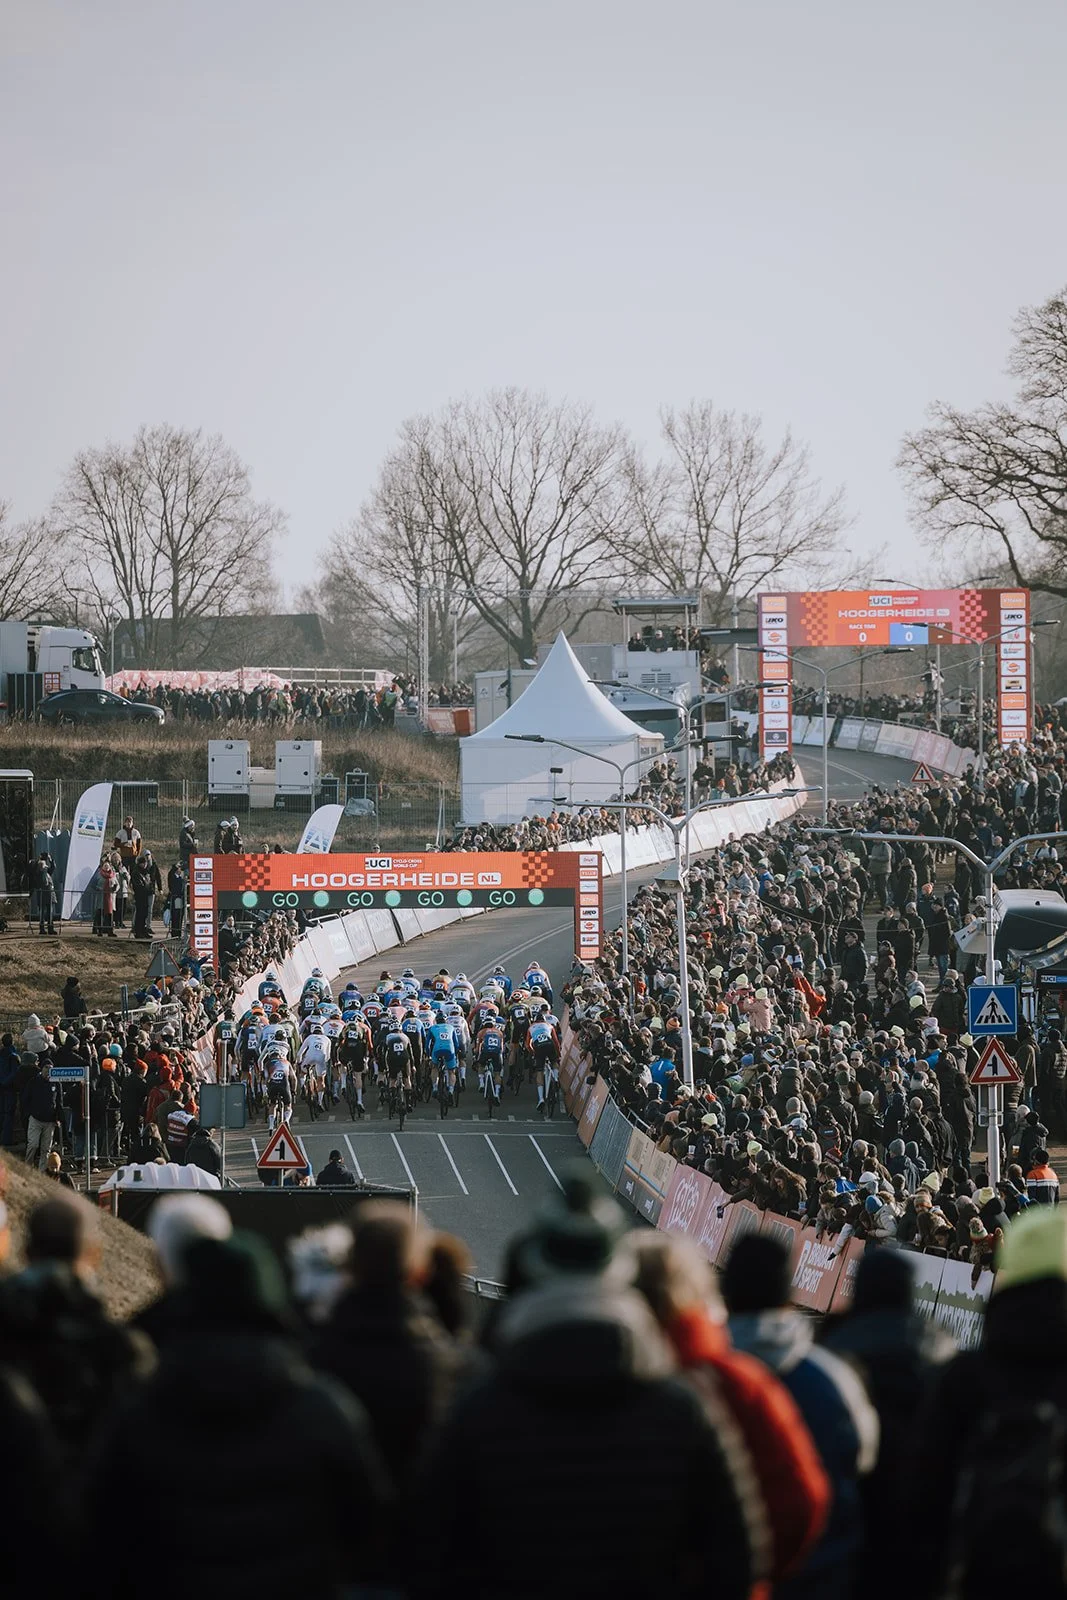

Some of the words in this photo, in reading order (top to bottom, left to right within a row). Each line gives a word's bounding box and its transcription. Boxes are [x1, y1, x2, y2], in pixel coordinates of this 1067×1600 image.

[838, 608, 935, 618] HOOGERHEIDE
[859, 632, 867, 642] 0
[905, 632, 913, 642] 0
[370, 859, 390, 868] UCI
[292, 872, 474, 887] HOOGERHEIDE
[272, 892, 299, 906] GO
[347, 892, 374, 906] GO
[417, 891, 444, 906] GO
[489, 890, 516, 905] GO
